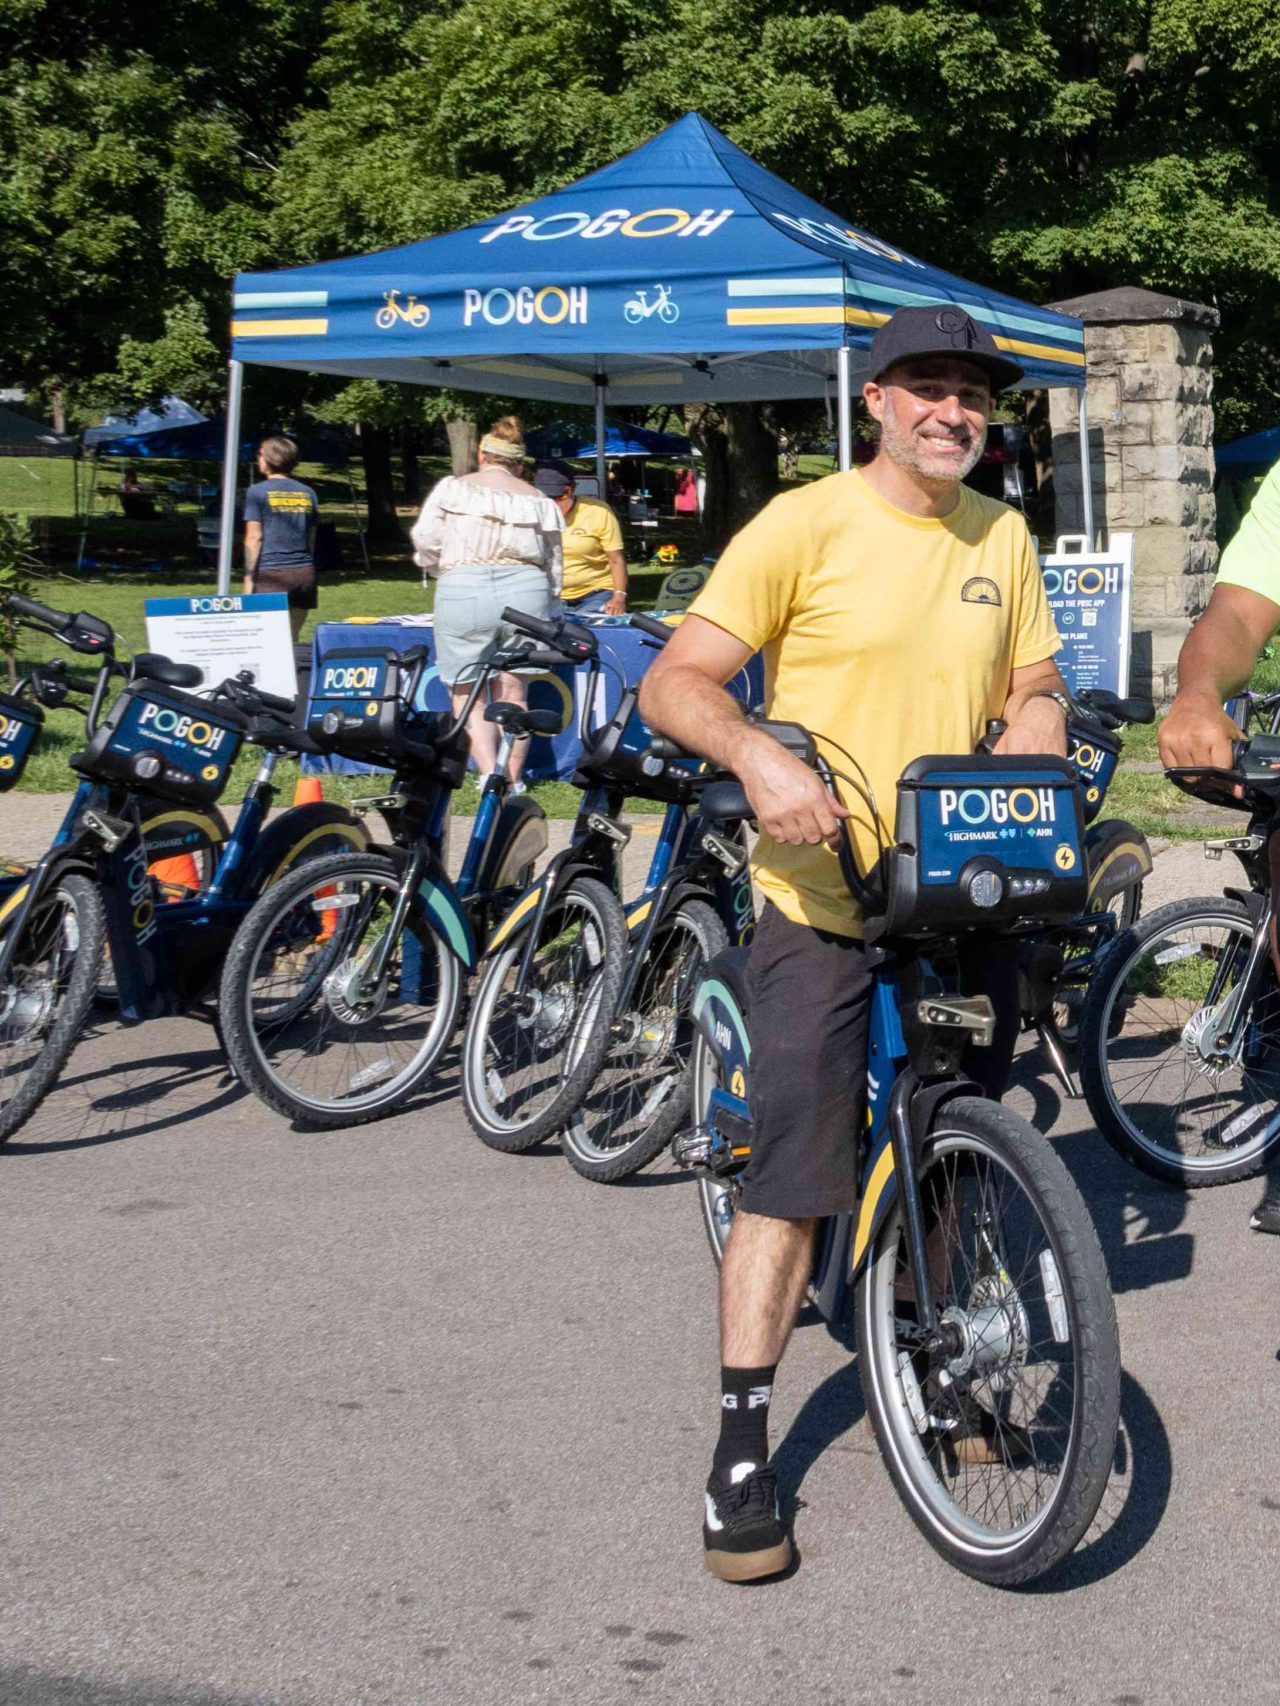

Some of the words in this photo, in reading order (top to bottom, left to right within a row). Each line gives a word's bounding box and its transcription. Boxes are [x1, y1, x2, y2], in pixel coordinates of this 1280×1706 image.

[479, 208, 733, 243] POGOH
[464, 286, 588, 326] POGOH
[1043, 567, 1118, 595] OGOH
[190, 597, 243, 612] POGOH
[323, 667, 378, 689] POGOH
[138, 703, 226, 750] POGOH
[940, 788, 1056, 825] POGOH
[944, 830, 999, 842] HIGHMARK
[1036, 828, 1053, 837] AHN
